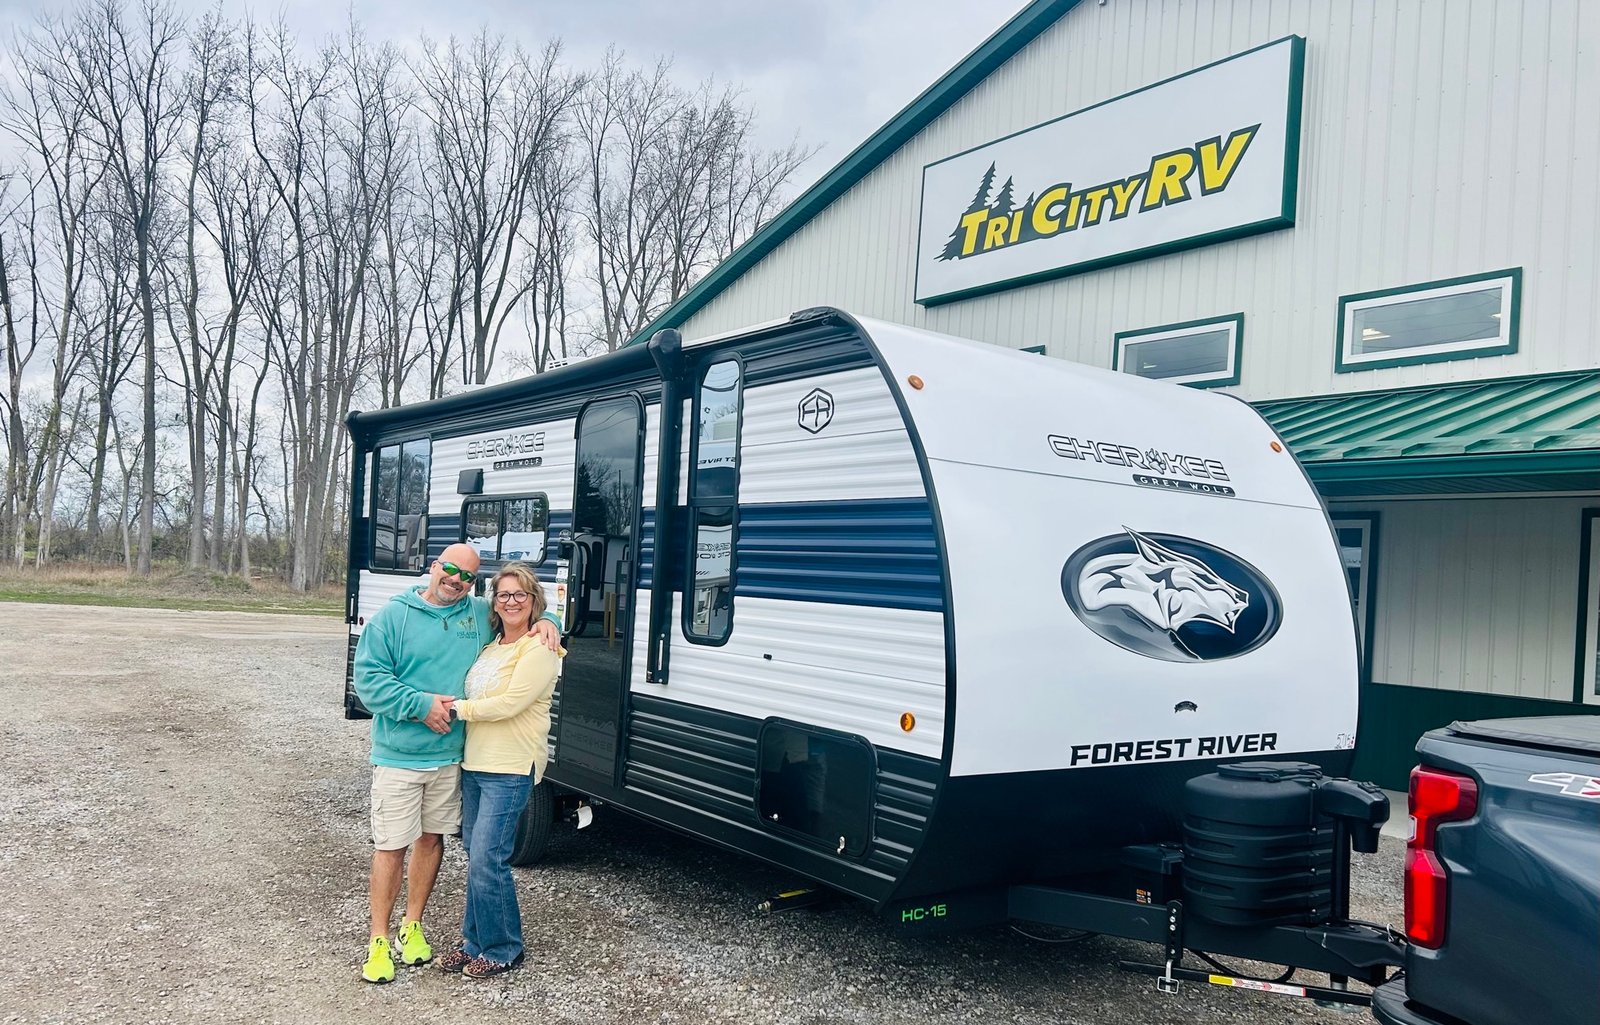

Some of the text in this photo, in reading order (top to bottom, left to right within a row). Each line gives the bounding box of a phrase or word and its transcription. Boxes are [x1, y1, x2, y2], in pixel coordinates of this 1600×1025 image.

[1139, 123, 1261, 213] RV
[495, 458, 541, 469] GREY WOLF
[1139, 476, 1231, 495] GREY WOLF
[1070, 732, 1278, 766] FOREST RIVER
[902, 904, 947, 922] HC-15
